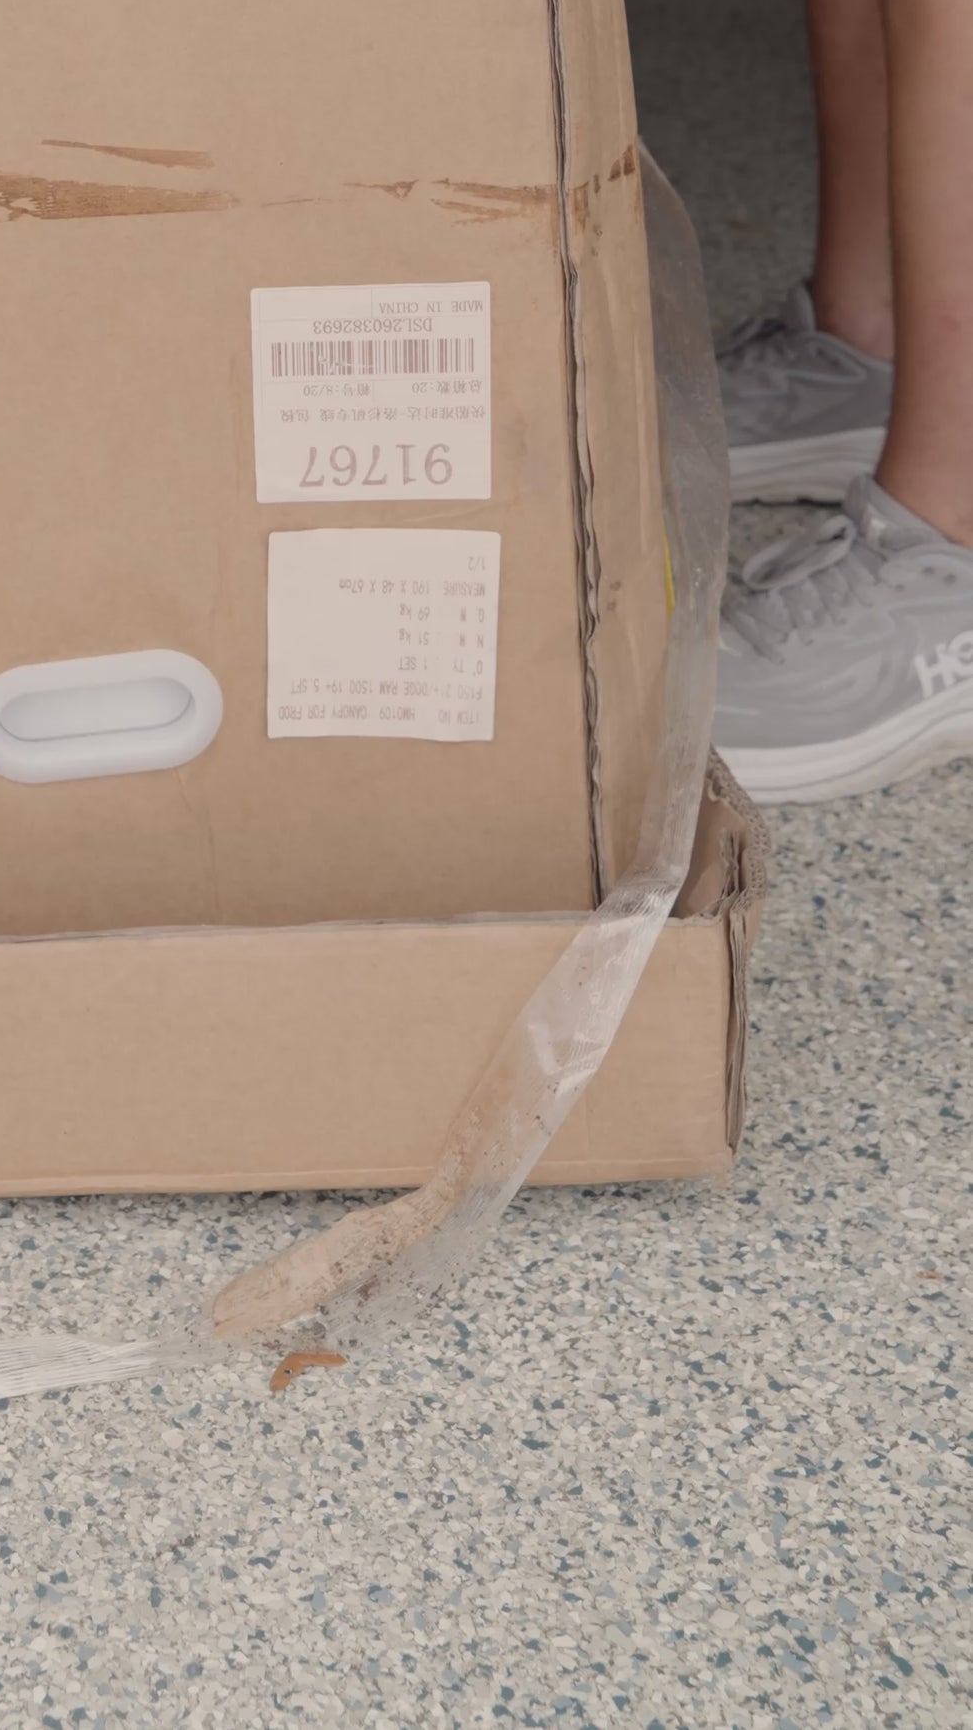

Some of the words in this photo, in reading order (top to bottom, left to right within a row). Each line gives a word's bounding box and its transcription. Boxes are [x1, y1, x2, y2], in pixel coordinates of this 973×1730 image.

[378, 301, 419, 314] CHINA
[426, 301, 442, 314] IN
[450, 299, 483, 313] MADE
[312, 317, 433, 334] DSL260382693
[279, 408, 310, 423] 包税
[298, 443, 453, 488] 91767
[382, 579, 395, 594] 48
[399, 603, 412, 620] kg
[398, 628, 411, 645] kg
[398, 657, 417, 671] SET
[378, 679, 398, 694] RAM
[307, 704, 326, 720] FOR
[331, 705, 368, 720] CANOPY
